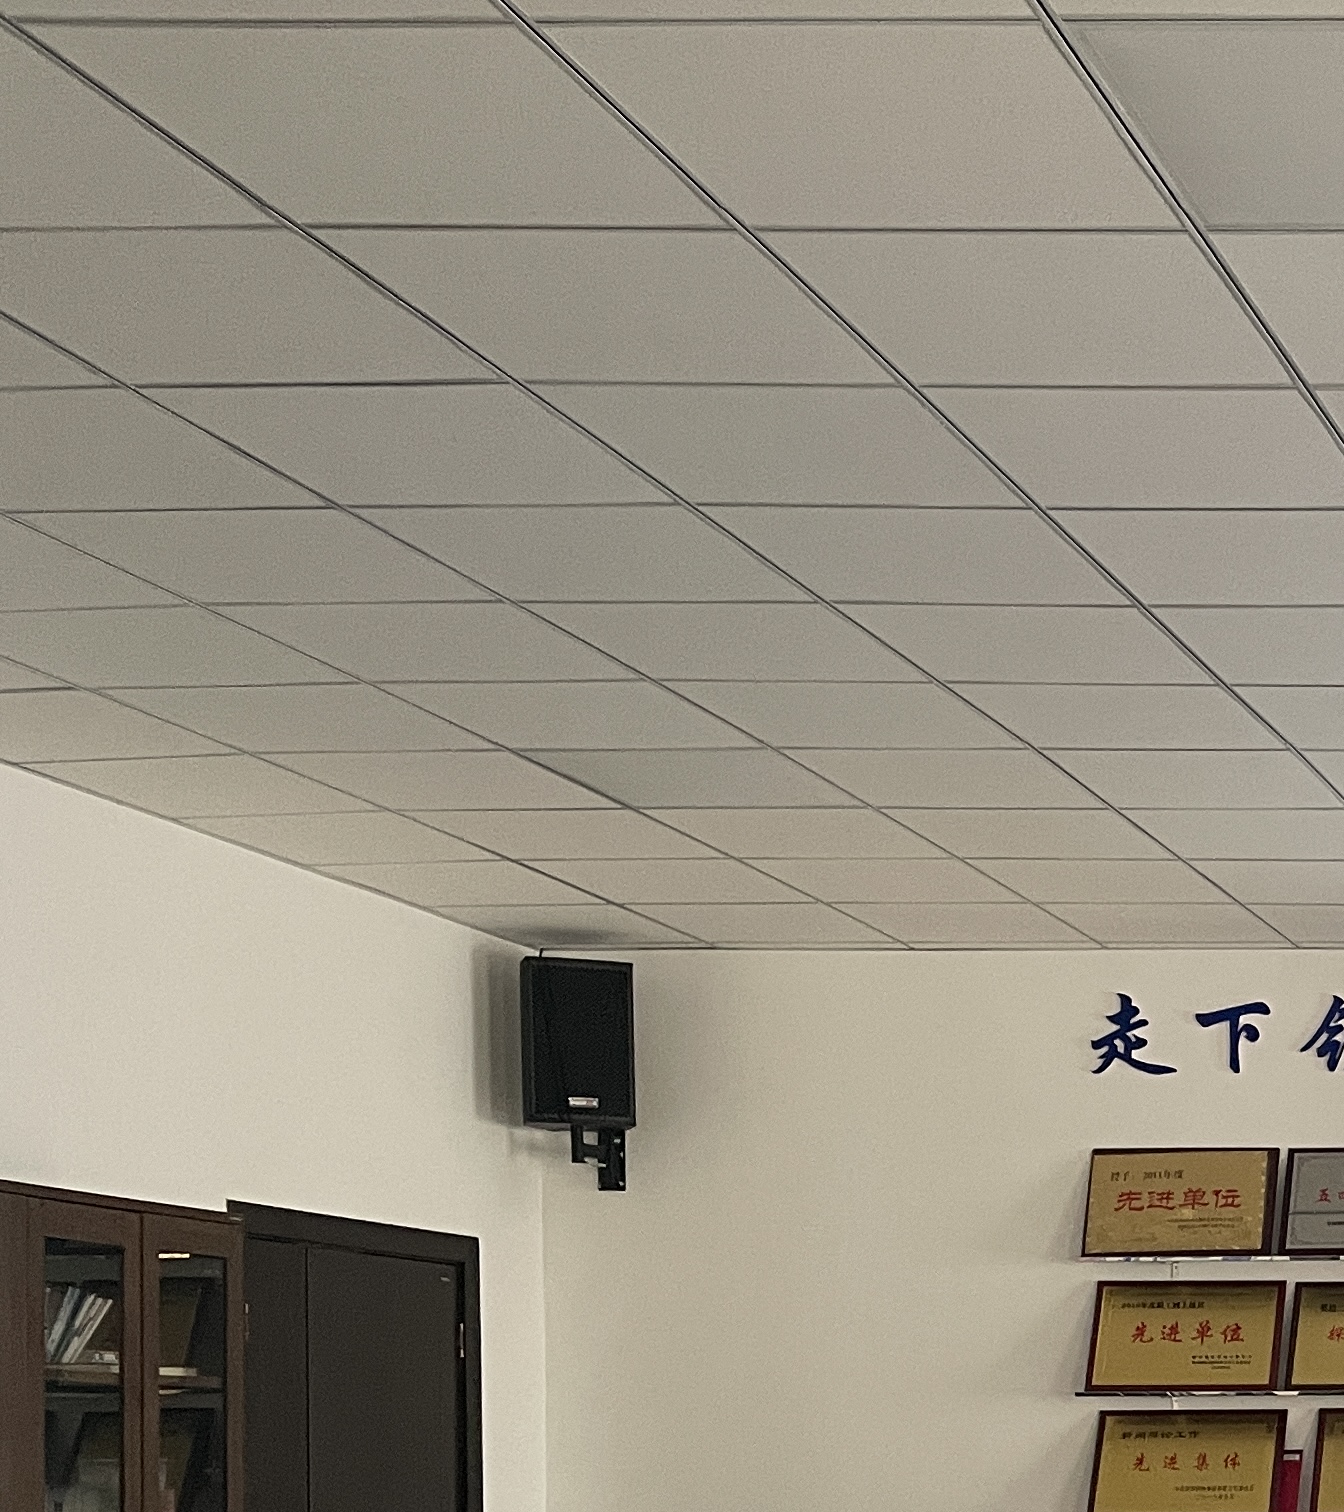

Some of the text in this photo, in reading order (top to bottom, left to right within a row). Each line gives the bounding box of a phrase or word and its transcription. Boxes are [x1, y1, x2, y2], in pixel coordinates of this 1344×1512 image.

[1114, 1187, 1242, 1212] 先进单位
[1131, 1318, 1245, 1346] 先进单位
[1131, 1451, 1242, 1473] 先进集体
